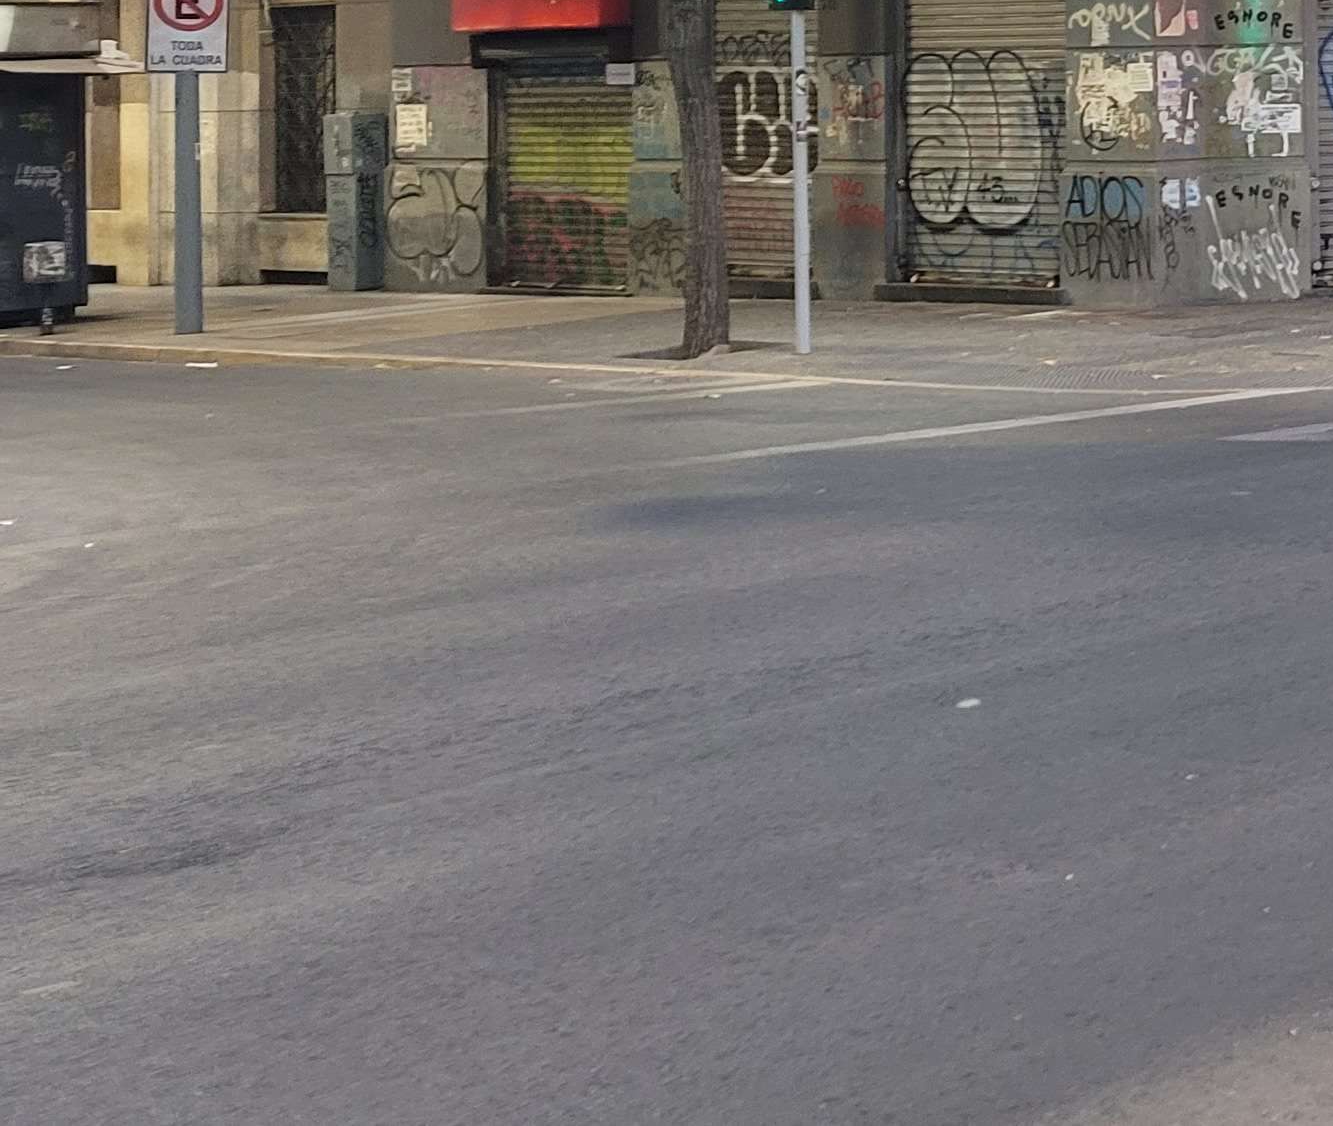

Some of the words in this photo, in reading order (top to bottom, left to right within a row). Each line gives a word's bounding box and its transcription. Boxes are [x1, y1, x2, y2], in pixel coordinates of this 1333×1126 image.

[170, 40, 203, 52] TODA
[150, 54, 166, 65] LA
[171, 54, 222, 66] CUADRA
